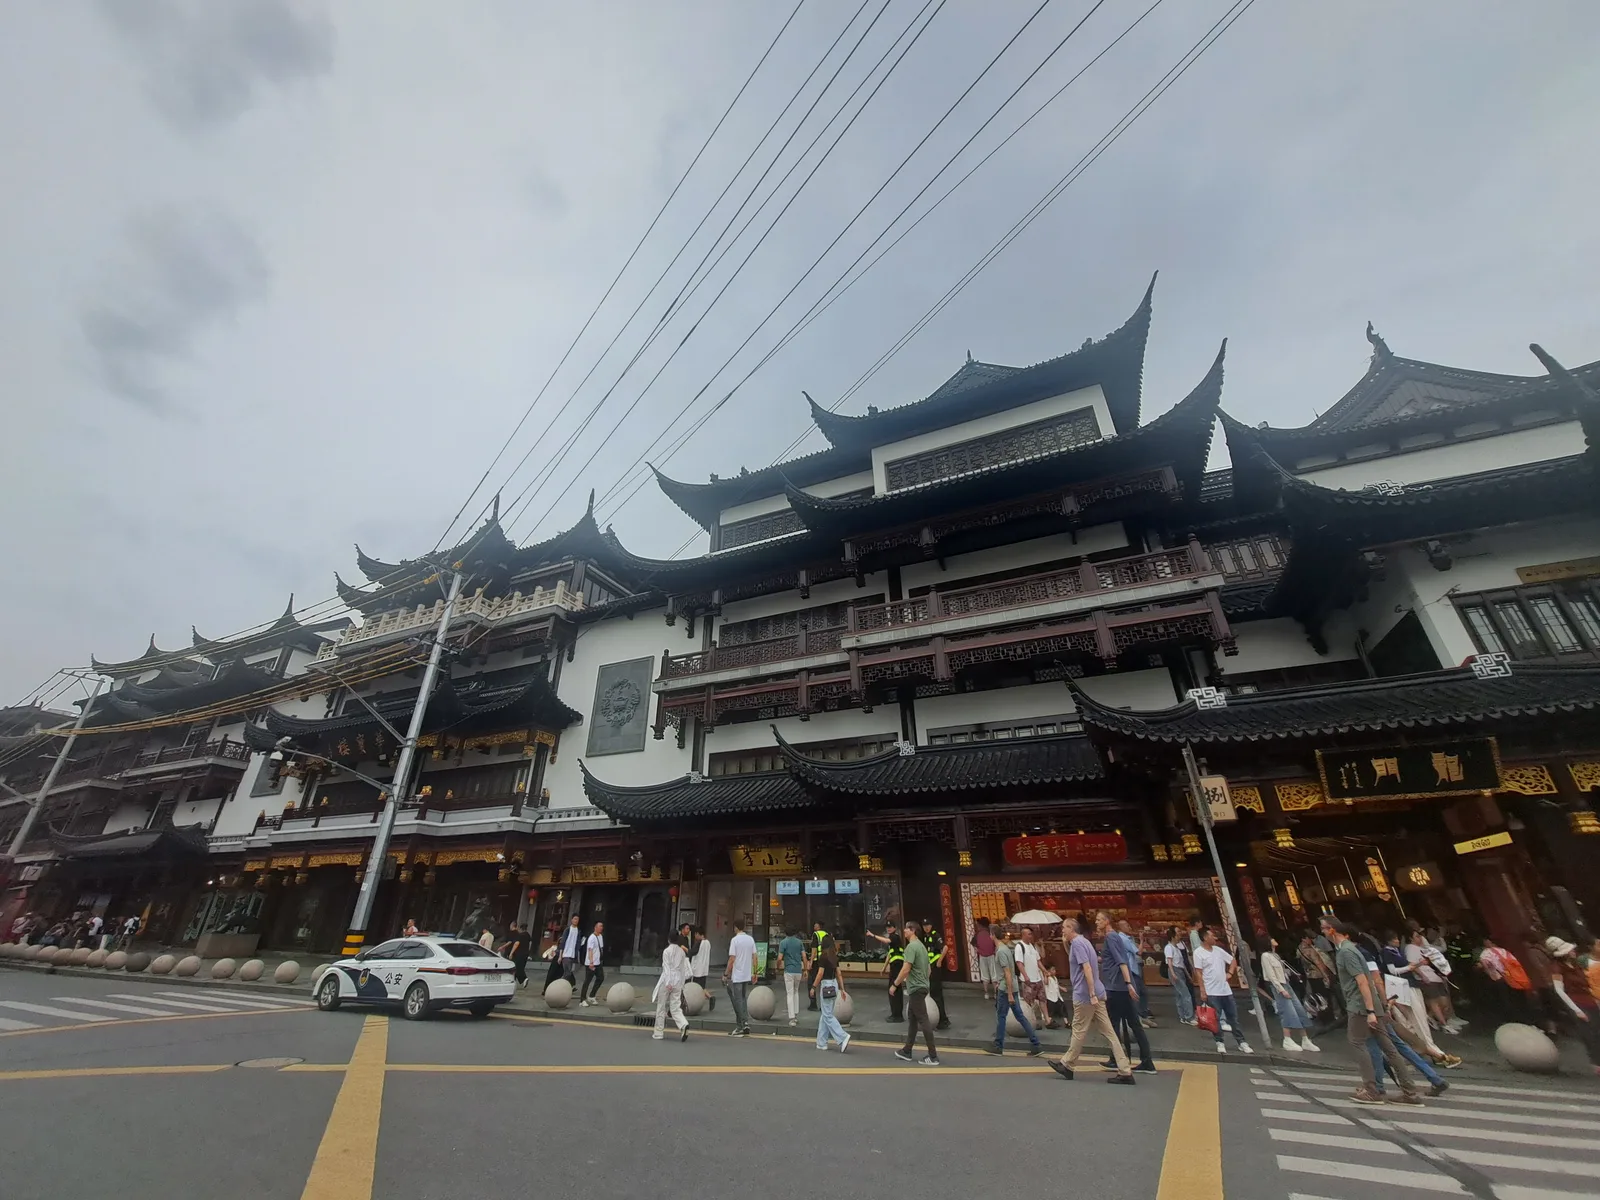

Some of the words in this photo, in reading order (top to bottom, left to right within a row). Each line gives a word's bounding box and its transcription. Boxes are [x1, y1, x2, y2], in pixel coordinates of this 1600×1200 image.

[1204, 785, 1228, 805] 捌
[1015, 840, 1069, 860] 稻香村
[384, 972, 404, 986] 公安
